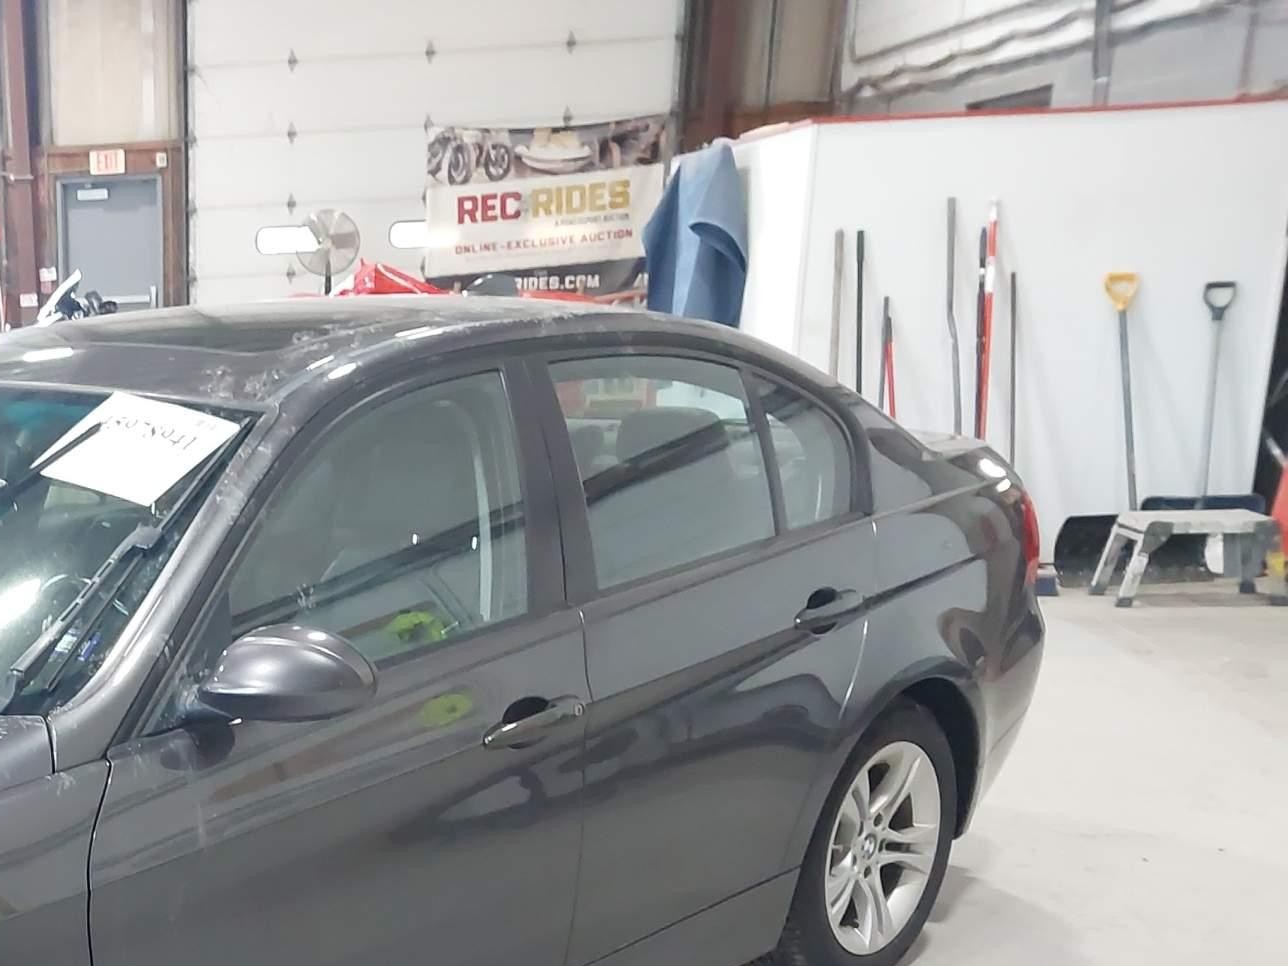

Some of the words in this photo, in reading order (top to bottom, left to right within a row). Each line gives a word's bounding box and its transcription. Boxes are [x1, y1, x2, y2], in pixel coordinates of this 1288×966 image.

[457, 192, 522, 224] REC
[531, 179, 630, 219] RIDES
[455, 234, 574, 255] ONLINE-EXCLUSIVE
[580, 228, 633, 243] AUCTION
